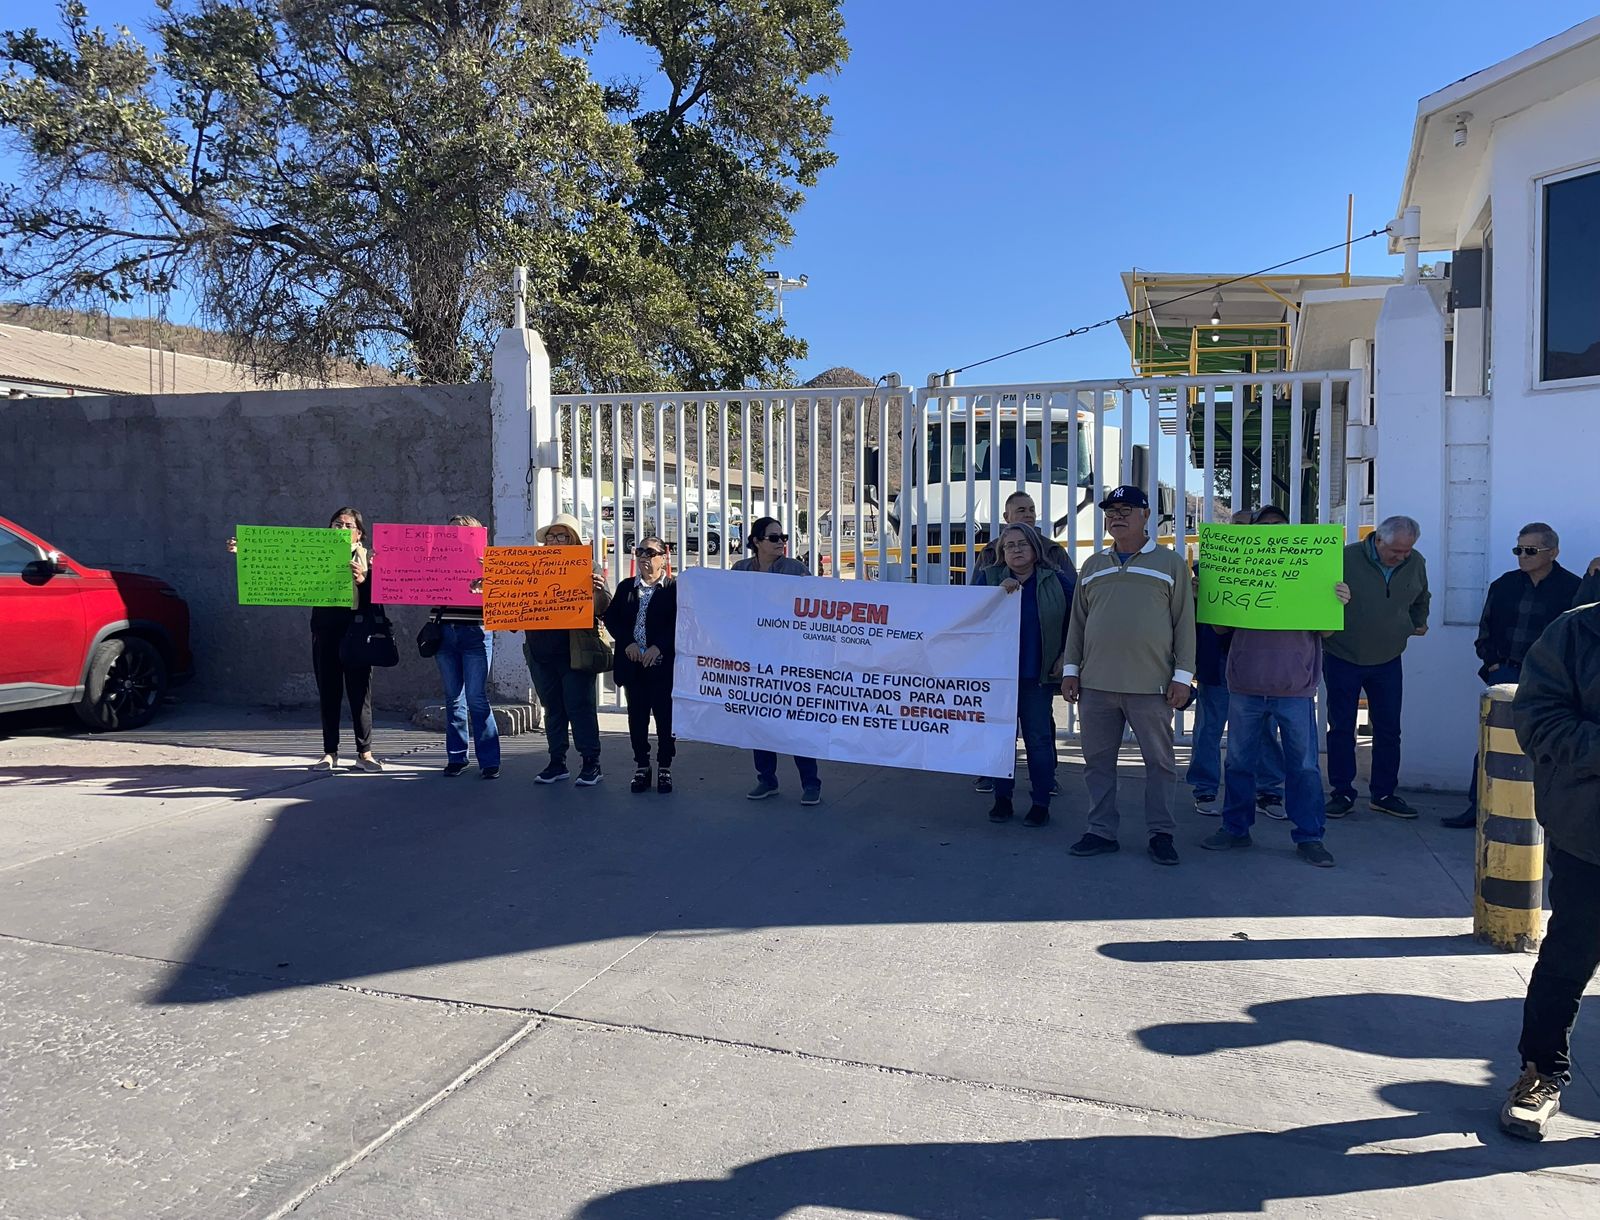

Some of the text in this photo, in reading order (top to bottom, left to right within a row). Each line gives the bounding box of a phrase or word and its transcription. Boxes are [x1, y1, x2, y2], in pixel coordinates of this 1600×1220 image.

[1202, 528, 1338, 546] QUEREMOS QUE SE NOS
[1200, 542, 1238, 554] RESUELVA
[1280, 546, 1323, 556] PRONTO
[1200, 550, 1308, 566] POSIBLE PORQUE LAS
[1200, 562, 1300, 578] ENFERMEDADES NO
[1218, 576, 1278, 588] ESPERAN.
[1208, 590, 1278, 610] URGE.
[794, 598, 888, 625] UJUPEM
[757, 617, 924, 640] UNIÓN DE JUBILADOS DE PEMEX
[697, 656, 991, 693] EXIGIMOS LA PRESENCIA DE FUNCIONARIOS
[702, 671, 982, 707] ADMINISTRATIVOS FACULTADOS PARA DAR
[700, 685, 986, 723] UNA SOLUCIÓN DEFINITIVA AL DEFICIENTE
[724, 702, 950, 734] SERVICIO MÉDICO EN ESTE LUGAR
